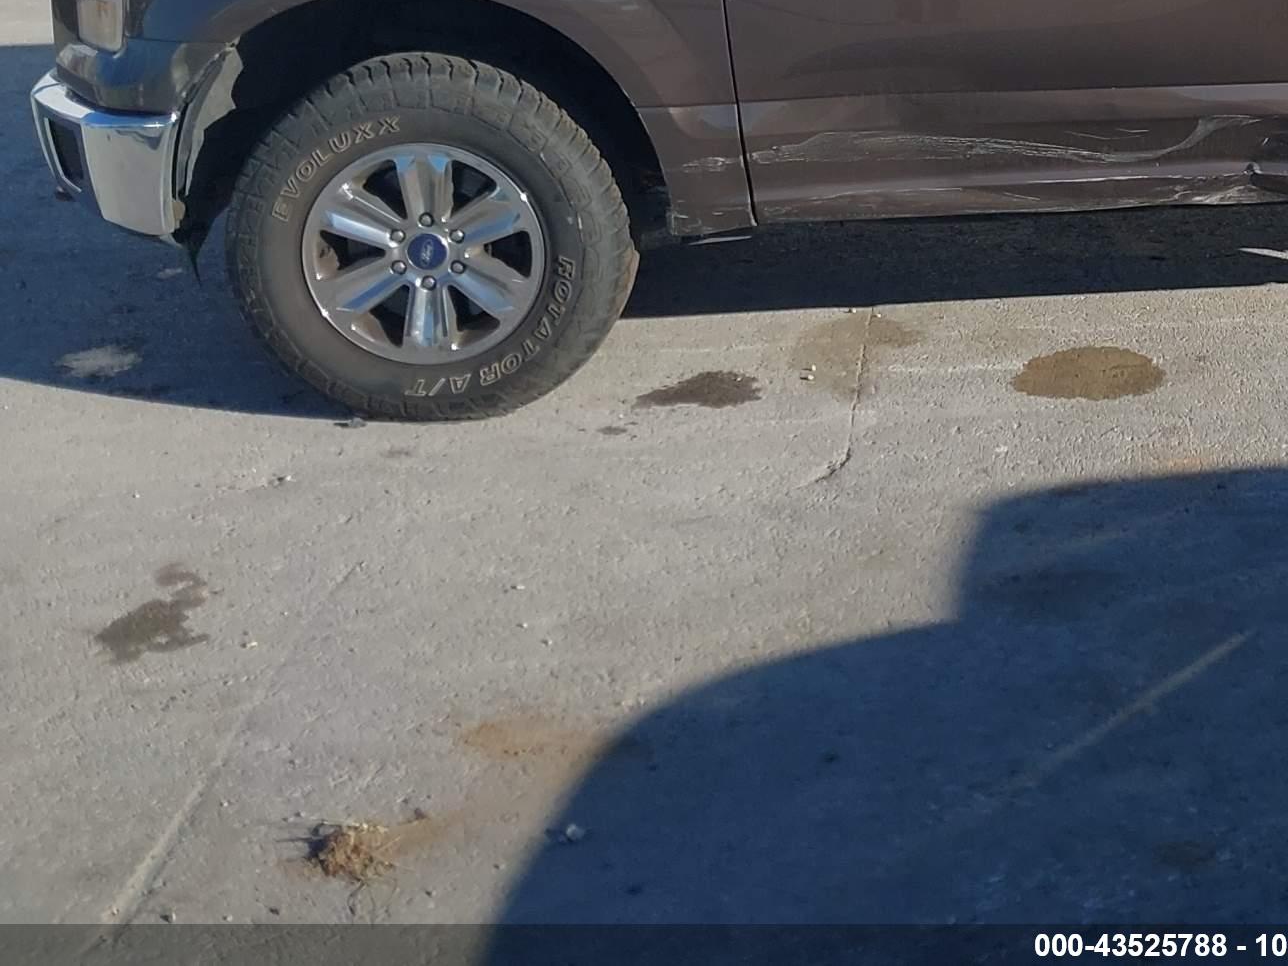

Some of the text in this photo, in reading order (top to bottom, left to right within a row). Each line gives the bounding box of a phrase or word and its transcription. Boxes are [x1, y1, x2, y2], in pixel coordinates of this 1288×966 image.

[271, 115, 401, 222] EVOLUXX
[405, 255, 576, 397] ROTATOR A/T
